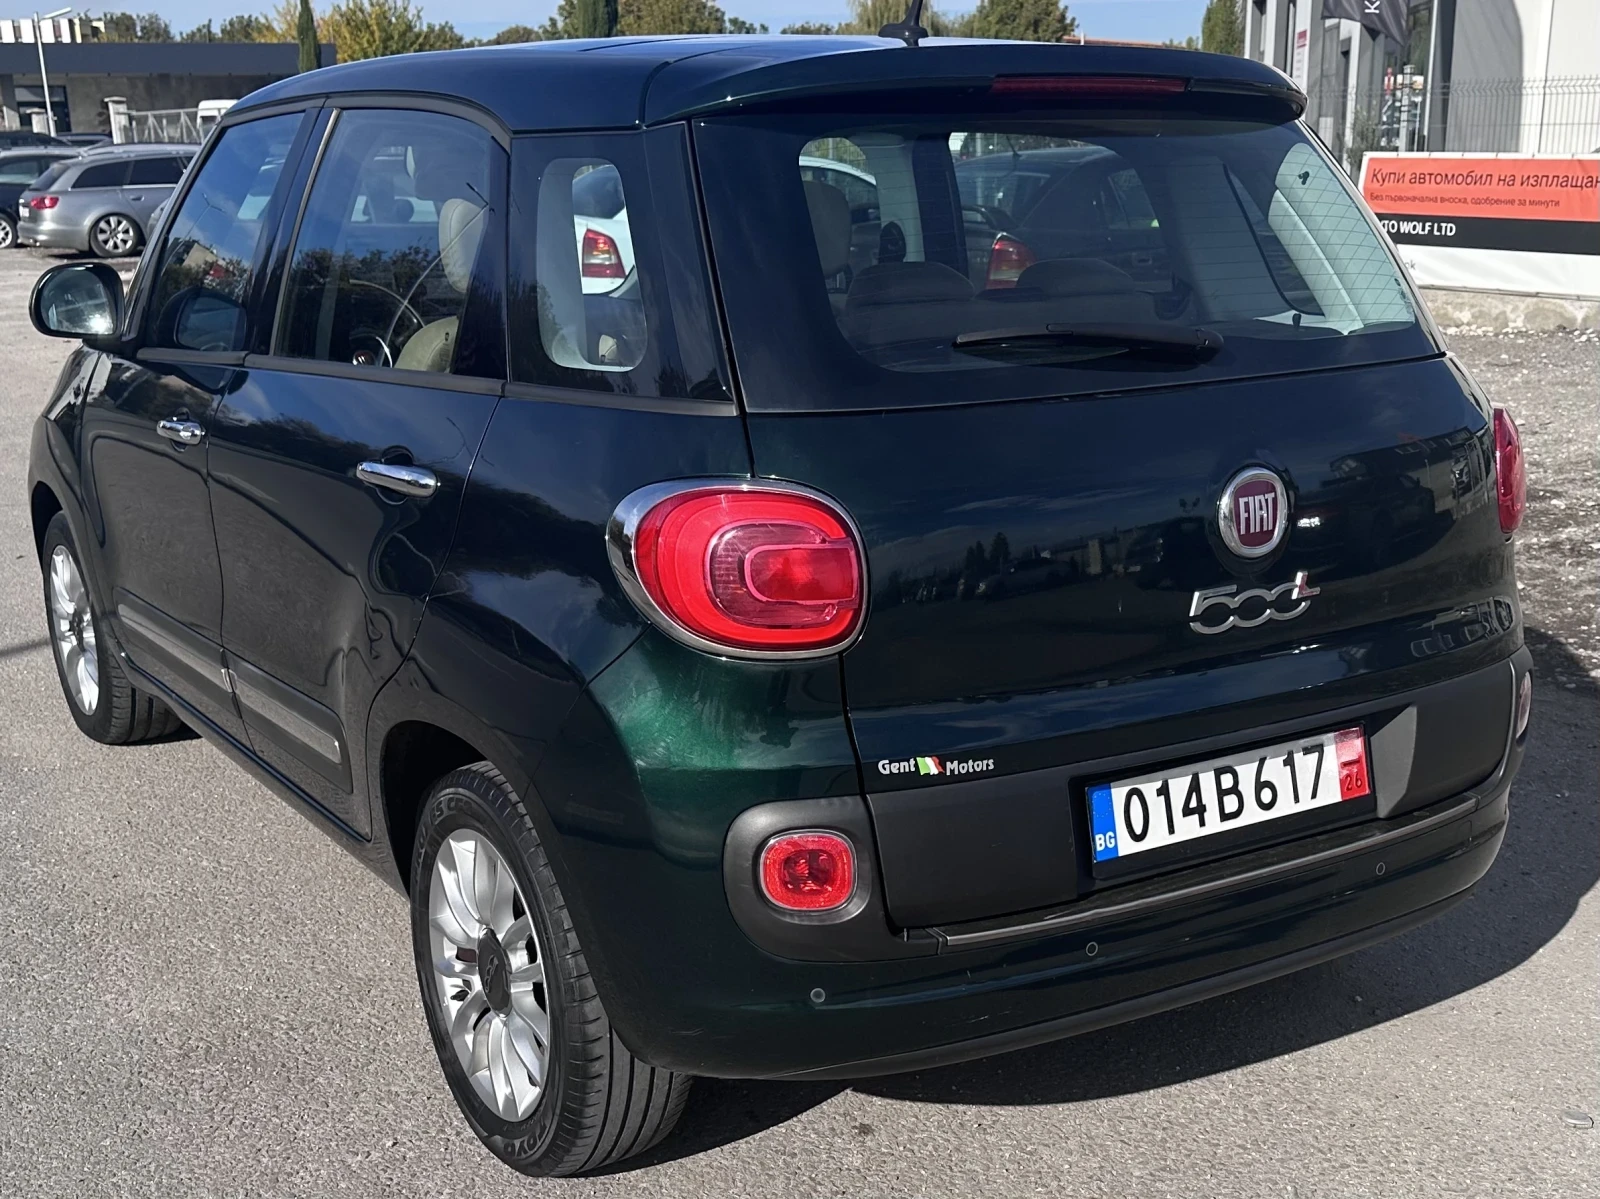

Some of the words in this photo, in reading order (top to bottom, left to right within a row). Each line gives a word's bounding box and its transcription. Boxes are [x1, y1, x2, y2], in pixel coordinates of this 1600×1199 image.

[1370, 168, 1406, 187] Купи
[1408, 170, 1493, 187] автомобил
[1497, 173, 1516, 187] на
[1369, 192, 1384, 201] Без
[1470, 197, 1516, 206] одобрение
[1517, 198, 1527, 207] за
[1528, 199, 1560, 209] минути
[1399, 221, 1433, 235] WOLF
[1433, 222, 1456, 237] LTD
[1238, 492, 1276, 536] FIAT
[877, 757, 916, 775] Gent
[945, 758, 995, 776] Motors
[1344, 771, 1363, 792] 26
[1094, 833, 1116, 852] BG
